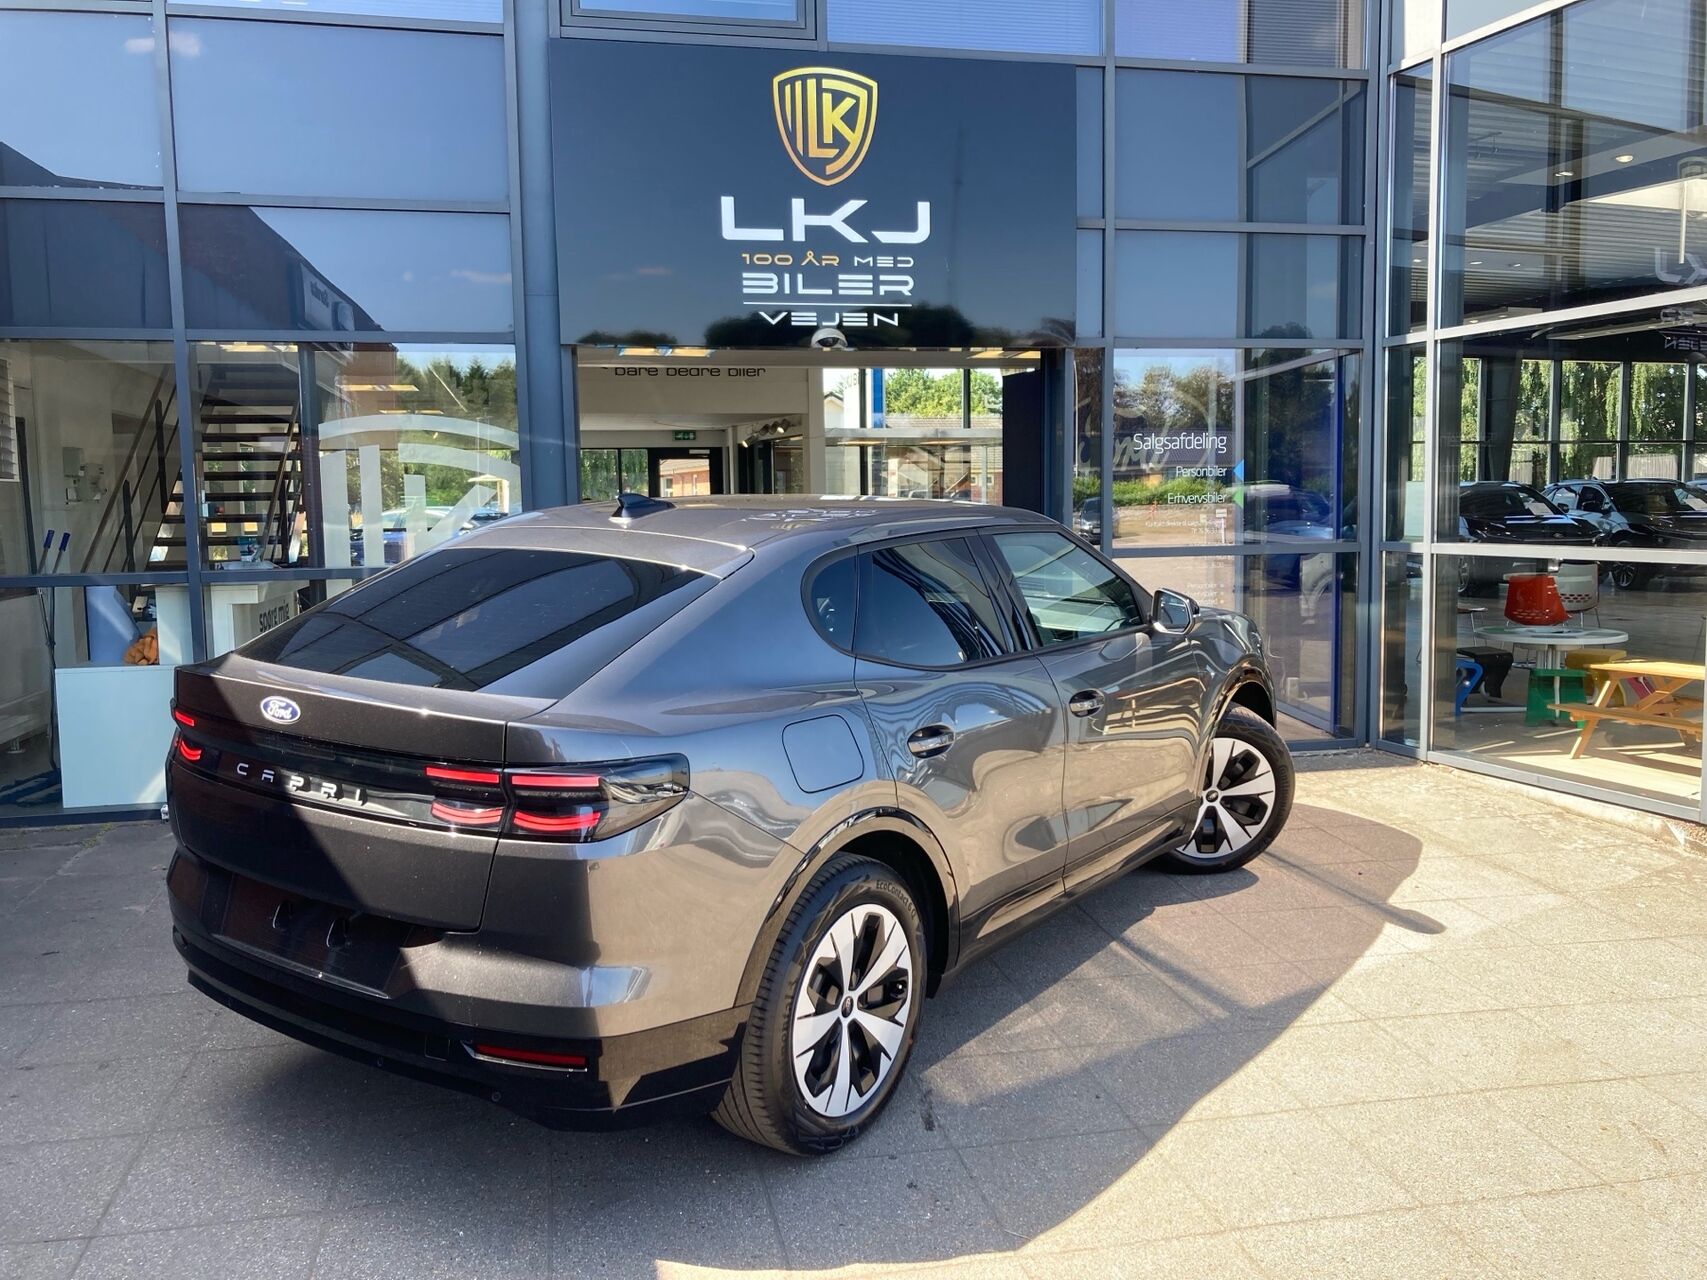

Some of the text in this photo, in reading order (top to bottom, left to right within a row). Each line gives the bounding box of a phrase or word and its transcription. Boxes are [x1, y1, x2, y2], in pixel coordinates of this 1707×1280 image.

[721, 196, 931, 244] LKJ
[742, 250, 914, 268] 100 ÅR MED
[742, 272, 915, 296] BILER
[758, 311, 899, 327] VEJEN
[614, 366, 659, 377] bare
[666, 367, 721, 377] bedre
[1133, 432, 1227, 454] Salgsafdeling
[1176, 465, 1227, 477] Personbiler
[1167, 492, 1227, 504] Erhvervsbiler
[266, 700, 294, 720] Ford
[236, 762, 361, 803] CAPRI
